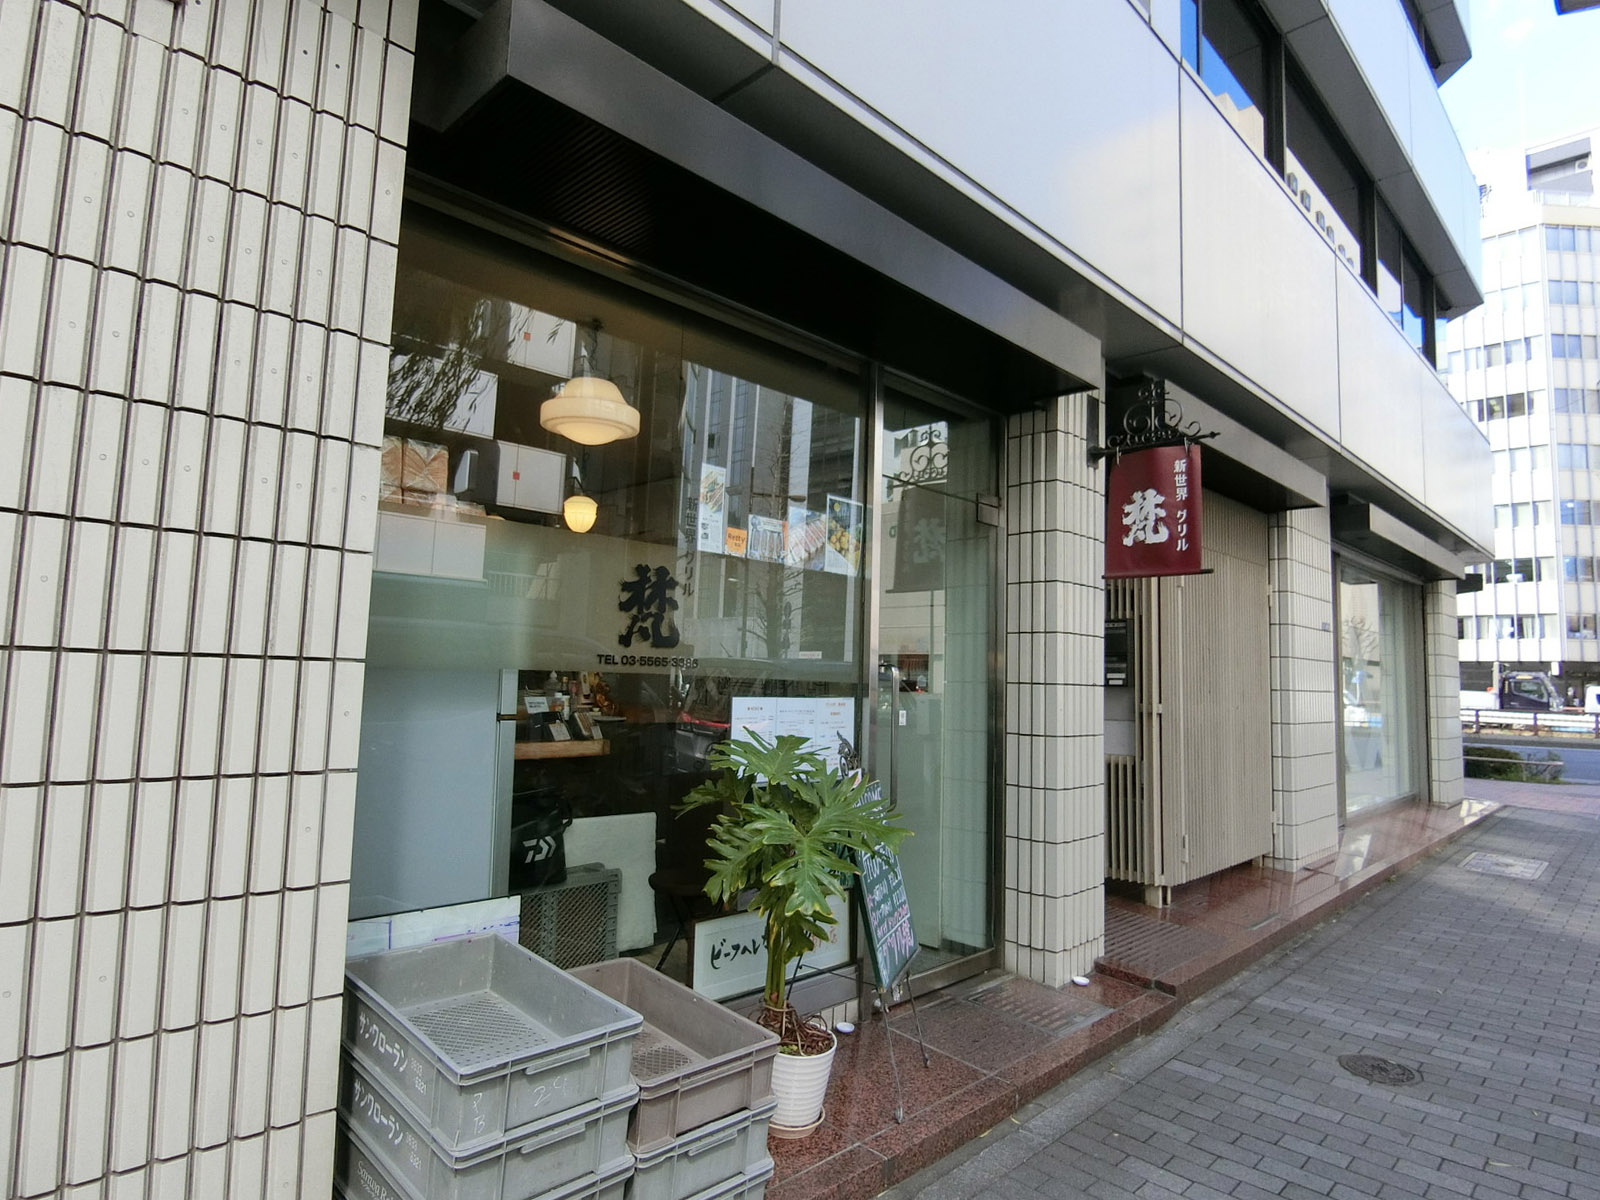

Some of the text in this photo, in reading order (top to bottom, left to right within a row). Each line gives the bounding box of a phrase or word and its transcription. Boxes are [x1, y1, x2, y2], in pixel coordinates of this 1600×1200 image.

[1174, 459, 1189, 552] 新世界 グリル
[680, 550, 695, 597] グリル
[597, 653, 619, 665] TEL
